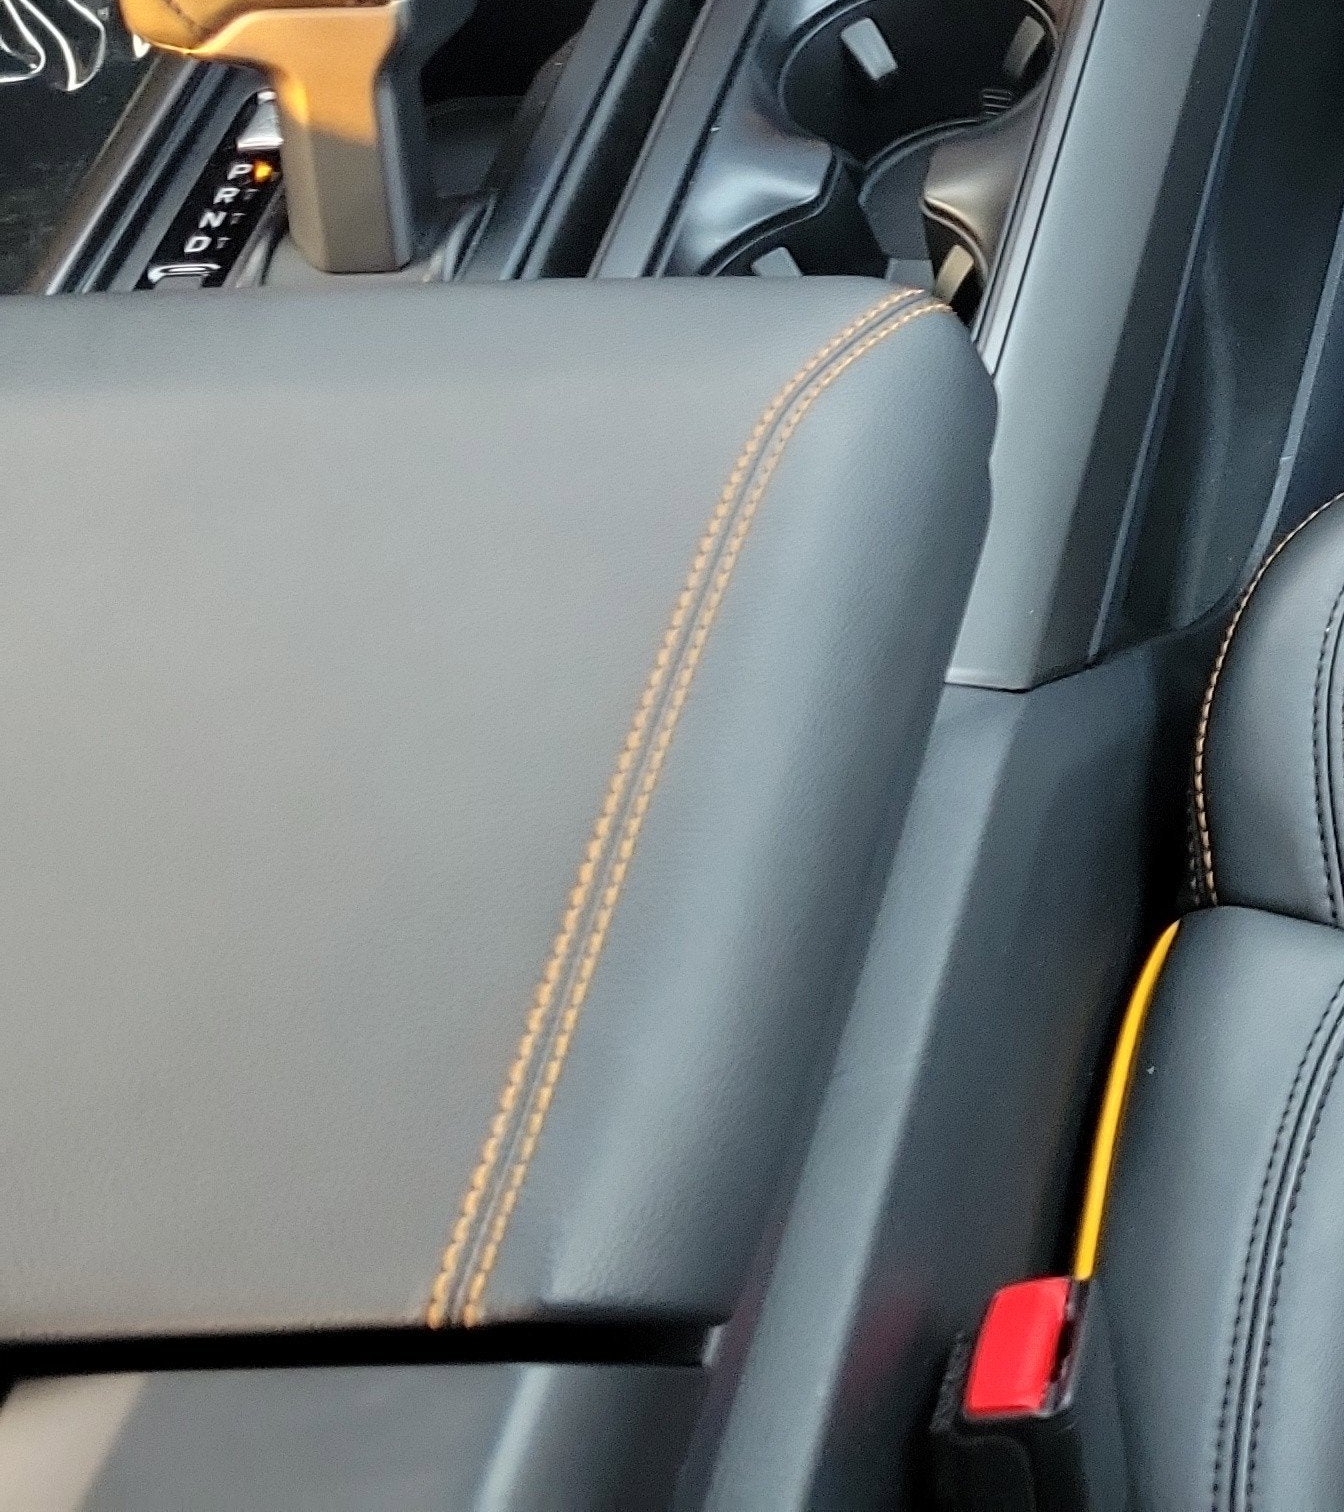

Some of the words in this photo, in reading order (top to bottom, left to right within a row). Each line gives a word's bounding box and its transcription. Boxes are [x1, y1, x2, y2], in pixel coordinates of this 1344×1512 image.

[227, 163, 254, 181] P
[212, 187, 241, 205] R
[198, 211, 227, 229] N
[184, 236, 213, 254] D
